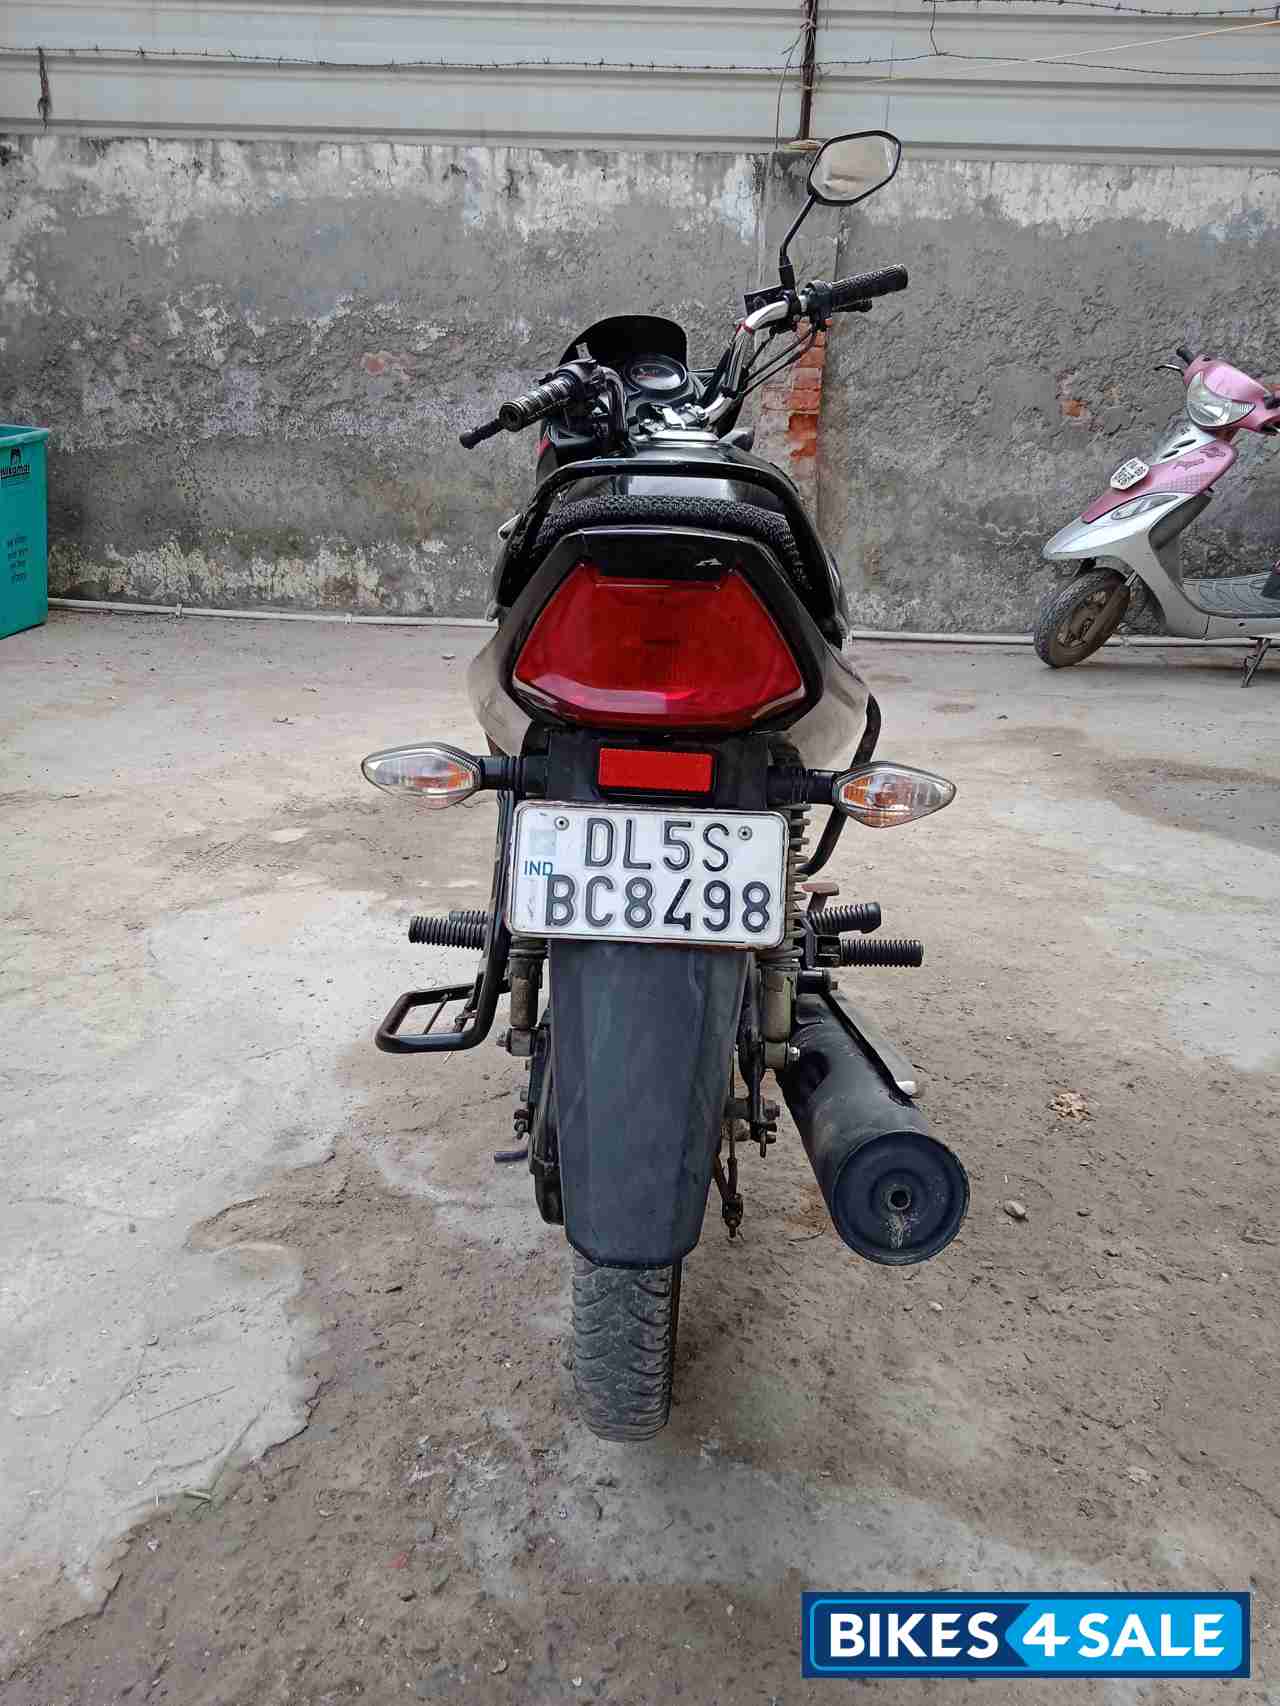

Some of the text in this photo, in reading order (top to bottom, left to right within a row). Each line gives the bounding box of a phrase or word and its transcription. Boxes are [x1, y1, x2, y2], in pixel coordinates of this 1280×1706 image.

[523, 860, 553, 877] IND
[584, 817, 730, 872] DL5S
[544, 874, 771, 933] BC8498
